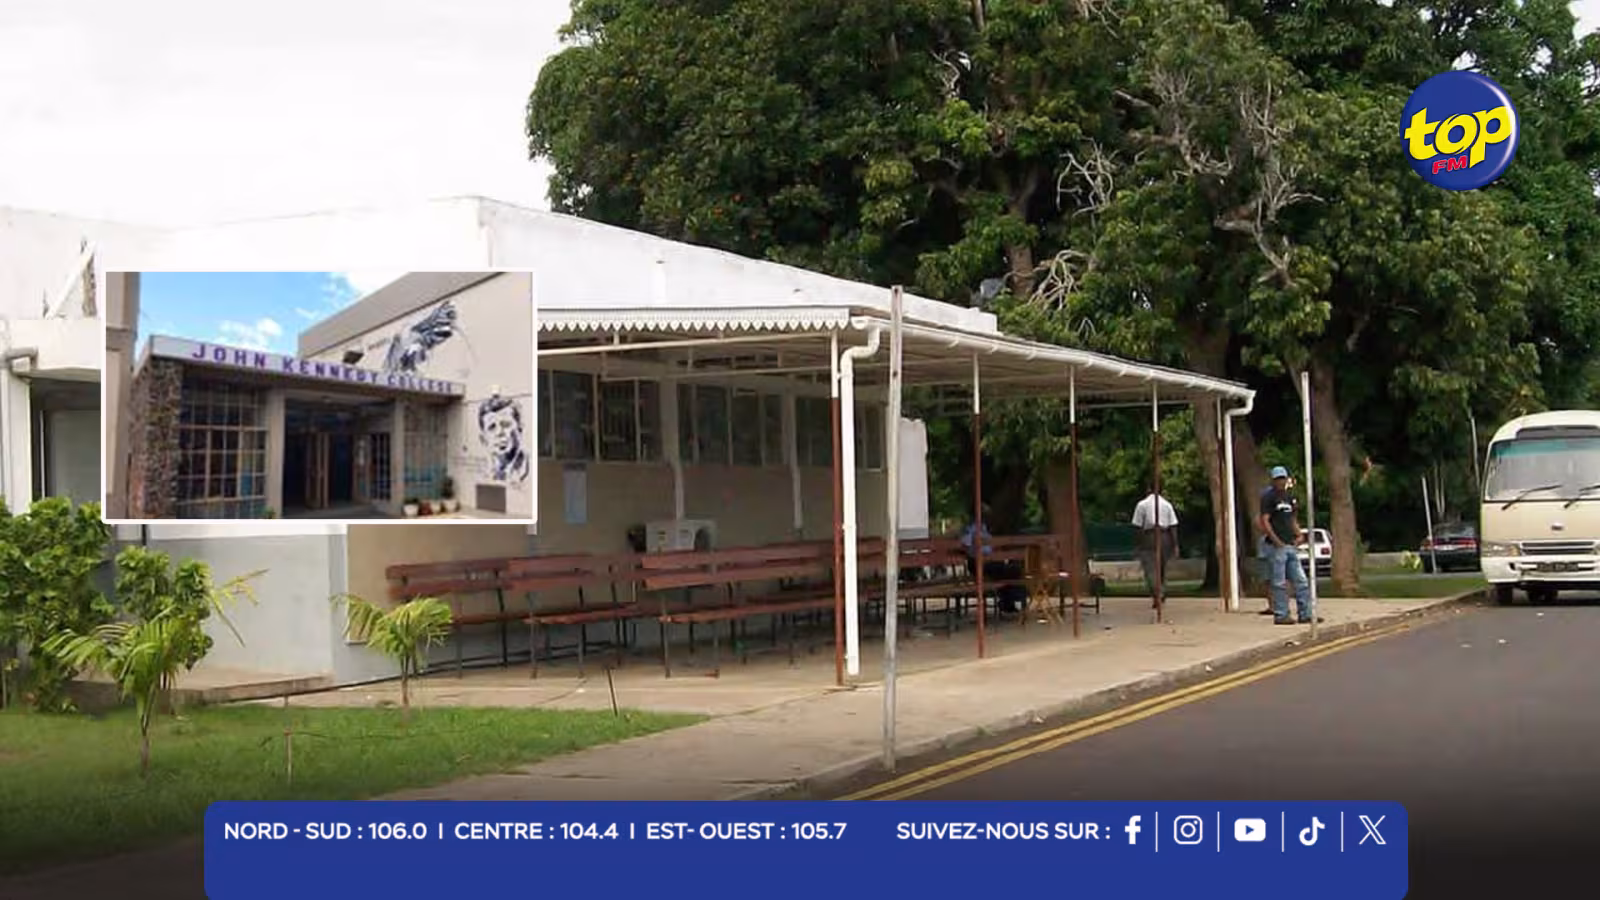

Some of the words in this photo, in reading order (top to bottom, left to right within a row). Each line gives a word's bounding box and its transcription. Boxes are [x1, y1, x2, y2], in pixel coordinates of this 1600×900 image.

[192, 344, 266, 369] JOHN
[282, 355, 379, 384] KENNEDY
[387, 373, 452, 393] COLLEGE
